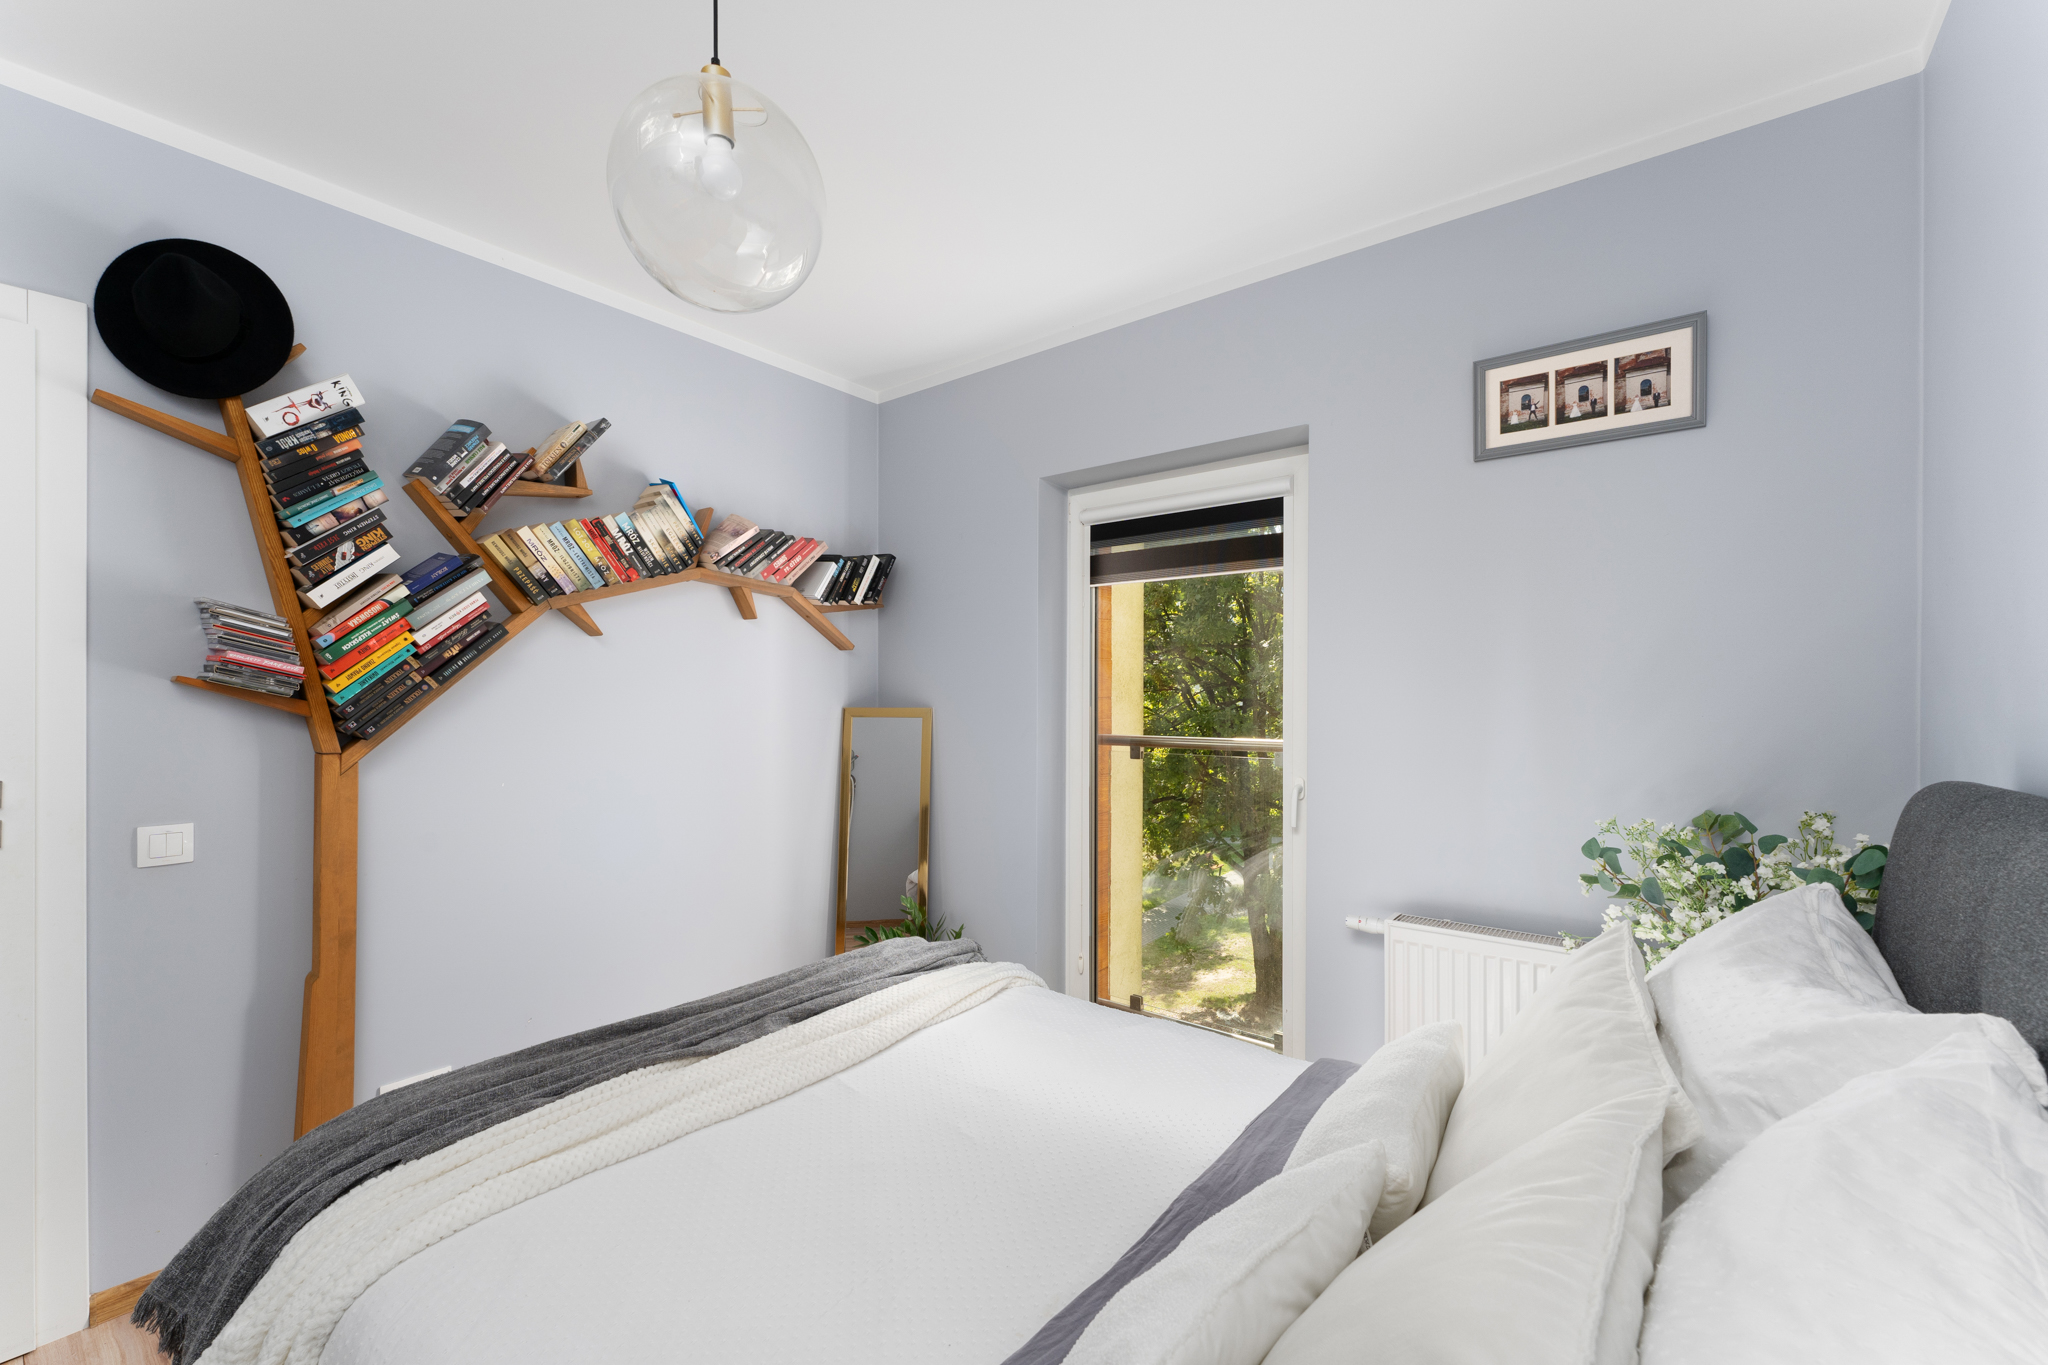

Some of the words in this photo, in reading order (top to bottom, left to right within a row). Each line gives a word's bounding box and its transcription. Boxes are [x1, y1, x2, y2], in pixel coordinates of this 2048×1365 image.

[331, 381, 354, 407] KING
[276, 434, 299, 450] KRÓL
[333, 429, 356, 444] BONDA
[310, 443, 318, 452] O
[541, 446, 564, 468] TOLKIEN
[357, 515, 379, 528] STEPHEN
[343, 526, 357, 536] KING
[355, 527, 385, 547] KING
[622, 521, 641, 545] MRÓZ
[360, 534, 388, 551] STEPHEN
[547, 538, 560, 553] MRÓZ
[562, 536, 575, 550] MRÓZ
[573, 527, 583, 539] LOT
[581, 539, 593, 552] 202
[611, 527, 635, 556] MRÓZ
[666, 527, 689, 561] EGZEKUCJA
[527, 538, 548, 562] MRÓZ
[666, 546, 680, 566] AFEKT
[311, 556, 333, 572] SUMMERS
[321, 563, 334, 574] BILLY
[359, 562, 374, 573] KING
[334, 571, 359, 589] INSTYTUT
[431, 566, 448, 579] KORAN
[514, 566, 538, 594] PRZEPAŚĆ
[533, 565, 549, 583] HALNY
[347, 604, 382, 628] NOSOWSKA
[381, 612, 400, 627] ŚWIAT
[342, 630, 372, 651] KIEPSKICH
[357, 644, 371, 655] GNIEW
[443, 643, 464, 659] TOTEM
[361, 659, 376, 670] ZIARNO
[345, 668, 362, 681] PRAWDY
[384, 668, 405, 684] TOLKIEN
[386, 683, 407, 700] TOLKIEN
[403, 688, 423, 704] TOLKIEN
